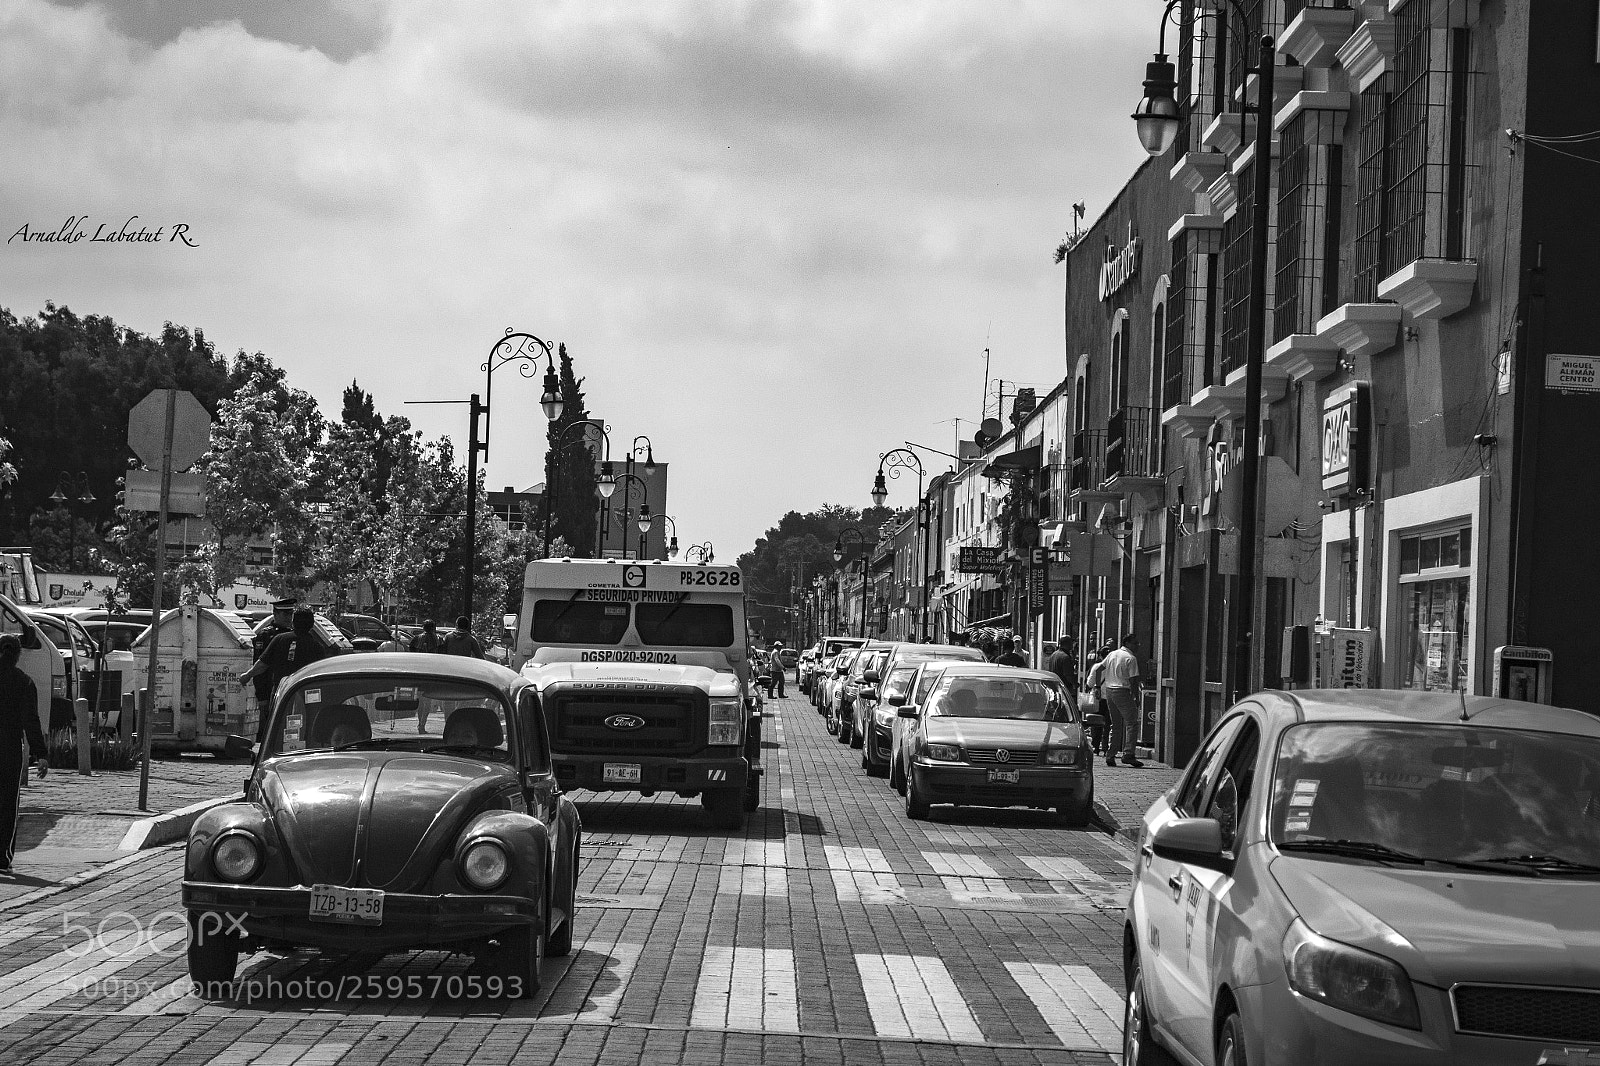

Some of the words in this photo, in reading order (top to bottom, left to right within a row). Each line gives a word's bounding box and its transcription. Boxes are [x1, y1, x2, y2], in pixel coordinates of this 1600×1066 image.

[1562, 362, 1593, 370] MIGUEL
[1560, 369, 1595, 377] ALEMÁN
[964, 548, 974, 556] La
[976, 548, 995, 557] Casa
[1033, 549, 1043, 564] E
[962, 555, 972, 563] del
[587, 589, 639, 602] SEGURIDAD
[642, 591, 680, 603] PRIVADA
[247, 598, 268, 606] Cholula
[581, 651, 678, 665] DGSP/020-92/024
[613, 716, 636, 727] Ford
[314, 894, 381, 914] TZB-13-58
